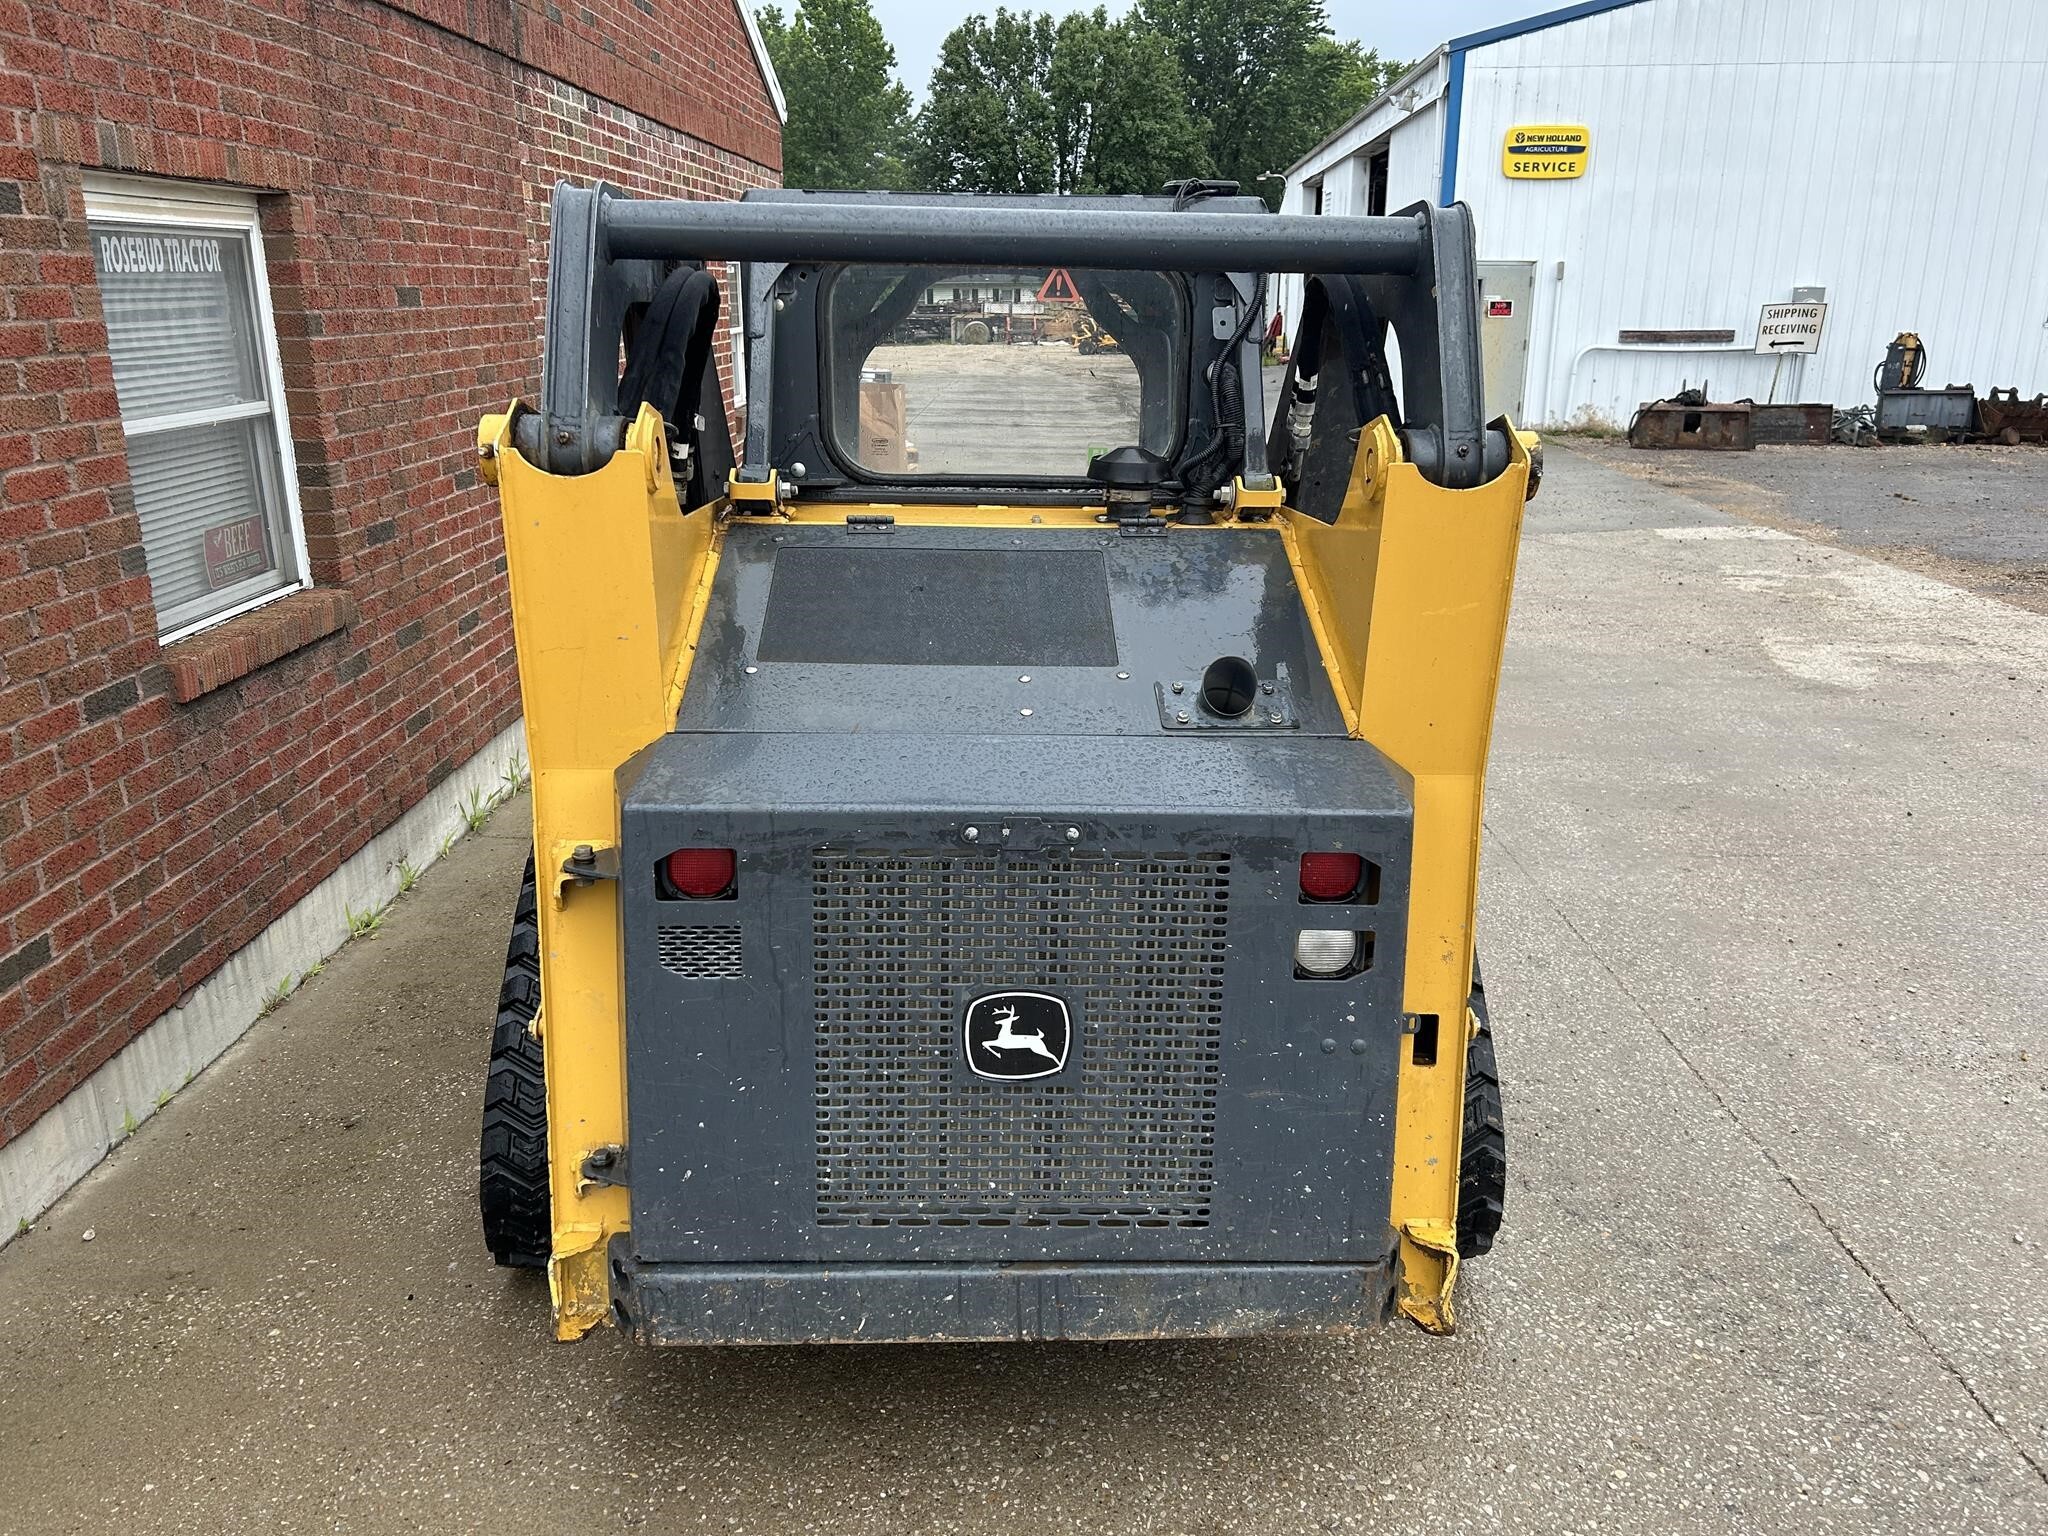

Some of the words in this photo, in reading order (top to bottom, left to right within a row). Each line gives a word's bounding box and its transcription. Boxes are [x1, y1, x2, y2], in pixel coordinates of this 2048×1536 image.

[1526, 134, 1545, 142] NEW
[1546, 134, 1582, 142] HOLLAND
[1513, 162, 1576, 172] SERVICE
[100, 236, 164, 272] ROSEBUD
[164, 238, 222, 272] TRACTOR
[1767, 308, 1818, 319] SHIPPING
[1762, 324, 1817, 335] RECEIVING
